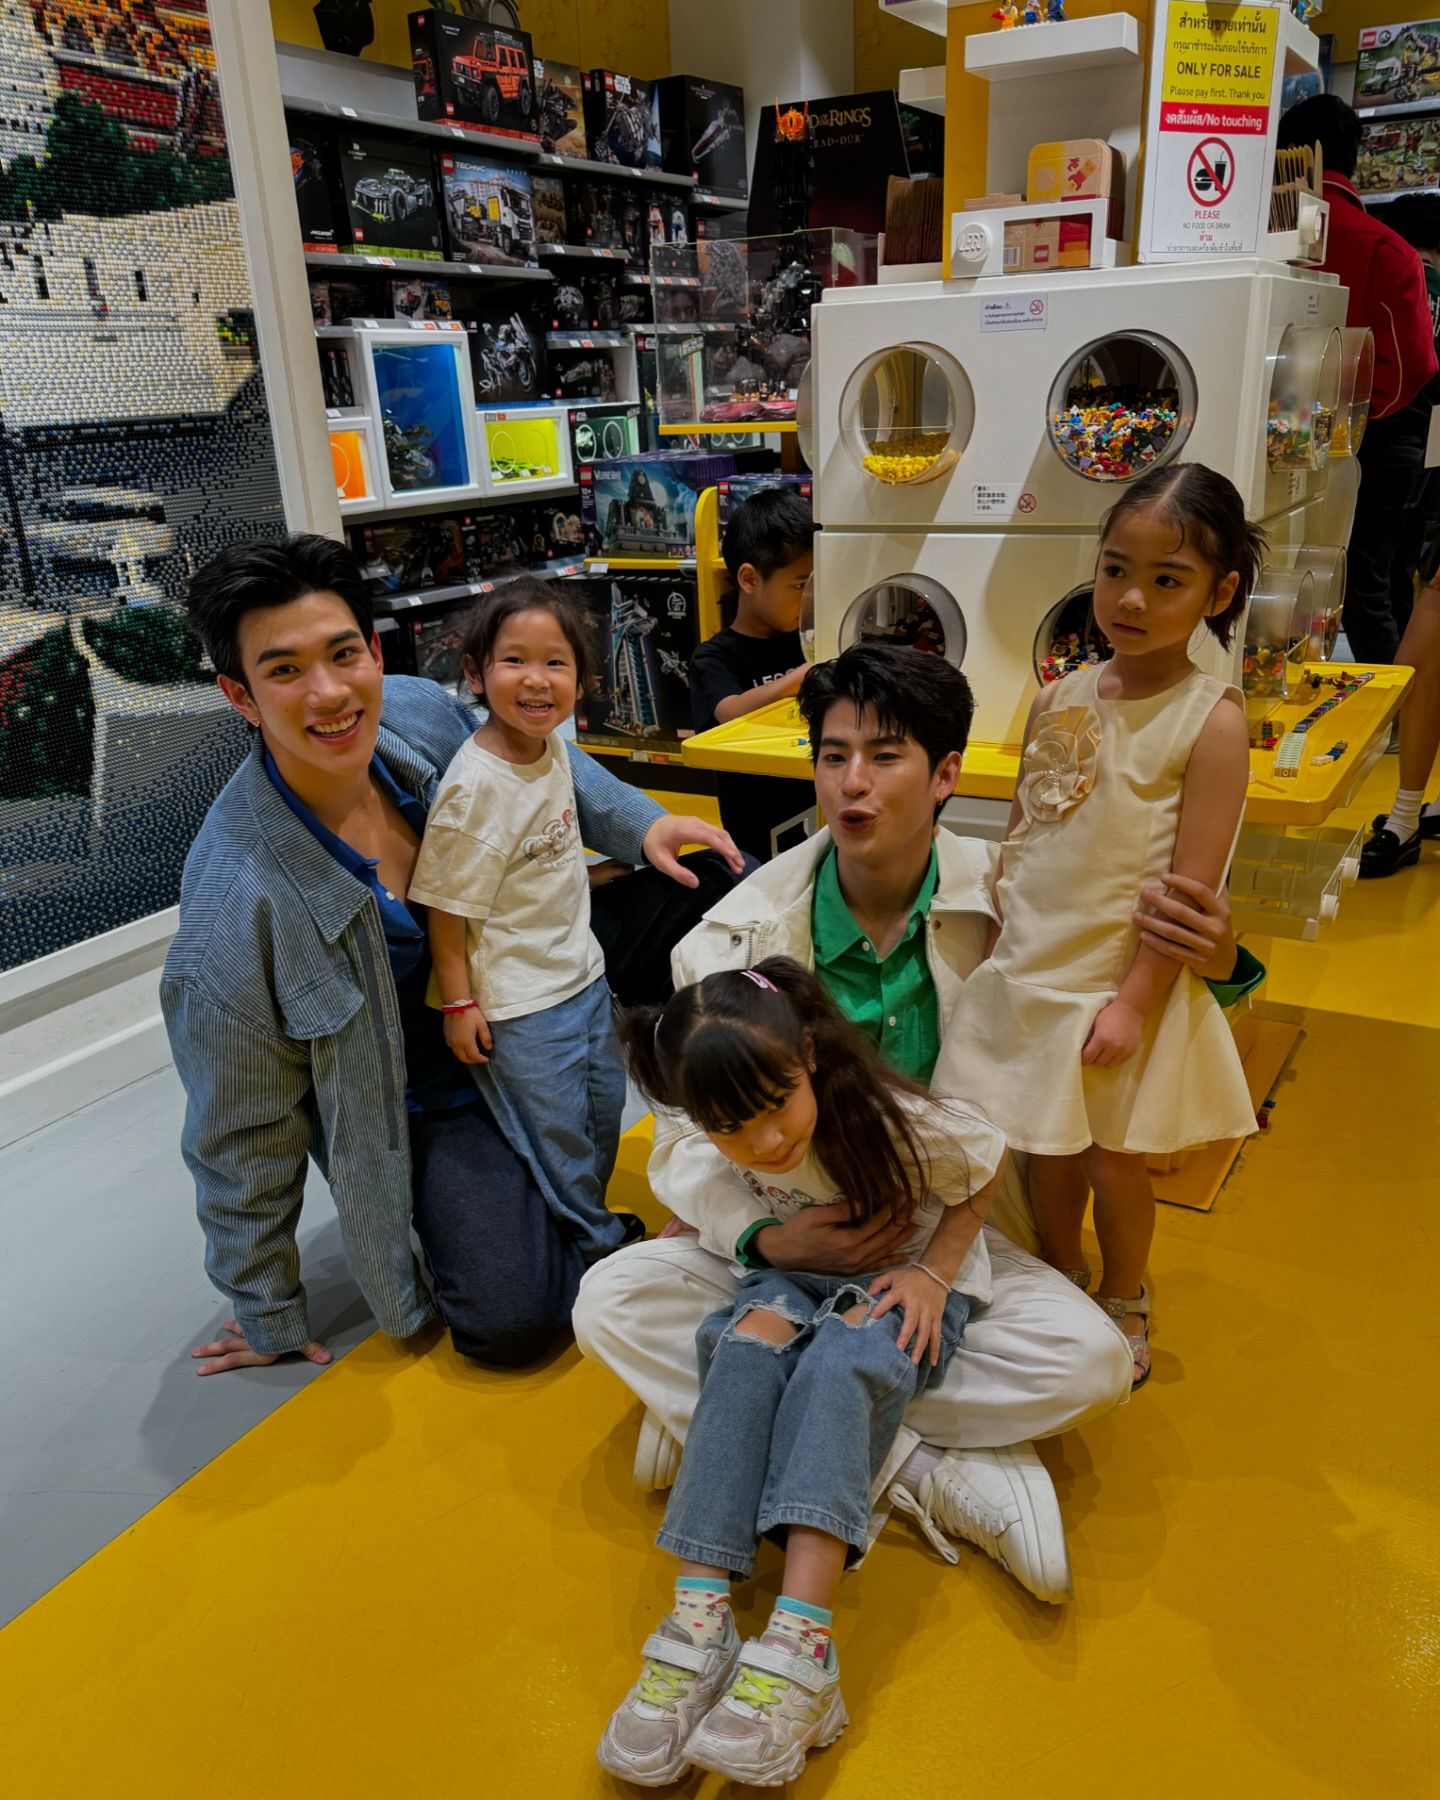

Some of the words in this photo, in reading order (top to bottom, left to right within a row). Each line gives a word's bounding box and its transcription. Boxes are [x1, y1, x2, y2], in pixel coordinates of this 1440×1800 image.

[1179, 10, 1266, 34] สำหรับขายเท่านั้น
[1176, 61, 1207, 76] ONLY
[1209, 63, 1231, 77] FOR
[1233, 65, 1262, 79] SALE
[1169, 85, 1194, 97] Please
[1195, 88, 1209, 99] pay
[1210, 87, 1227, 98] first.
[1229, 88, 1251, 99] Thank
[1251, 91, 1266, 101] you
[828, 107, 872, 127] RINGS
[1222, 114, 1263, 131] touching
[1193, 210, 1221, 219] PLEASE
